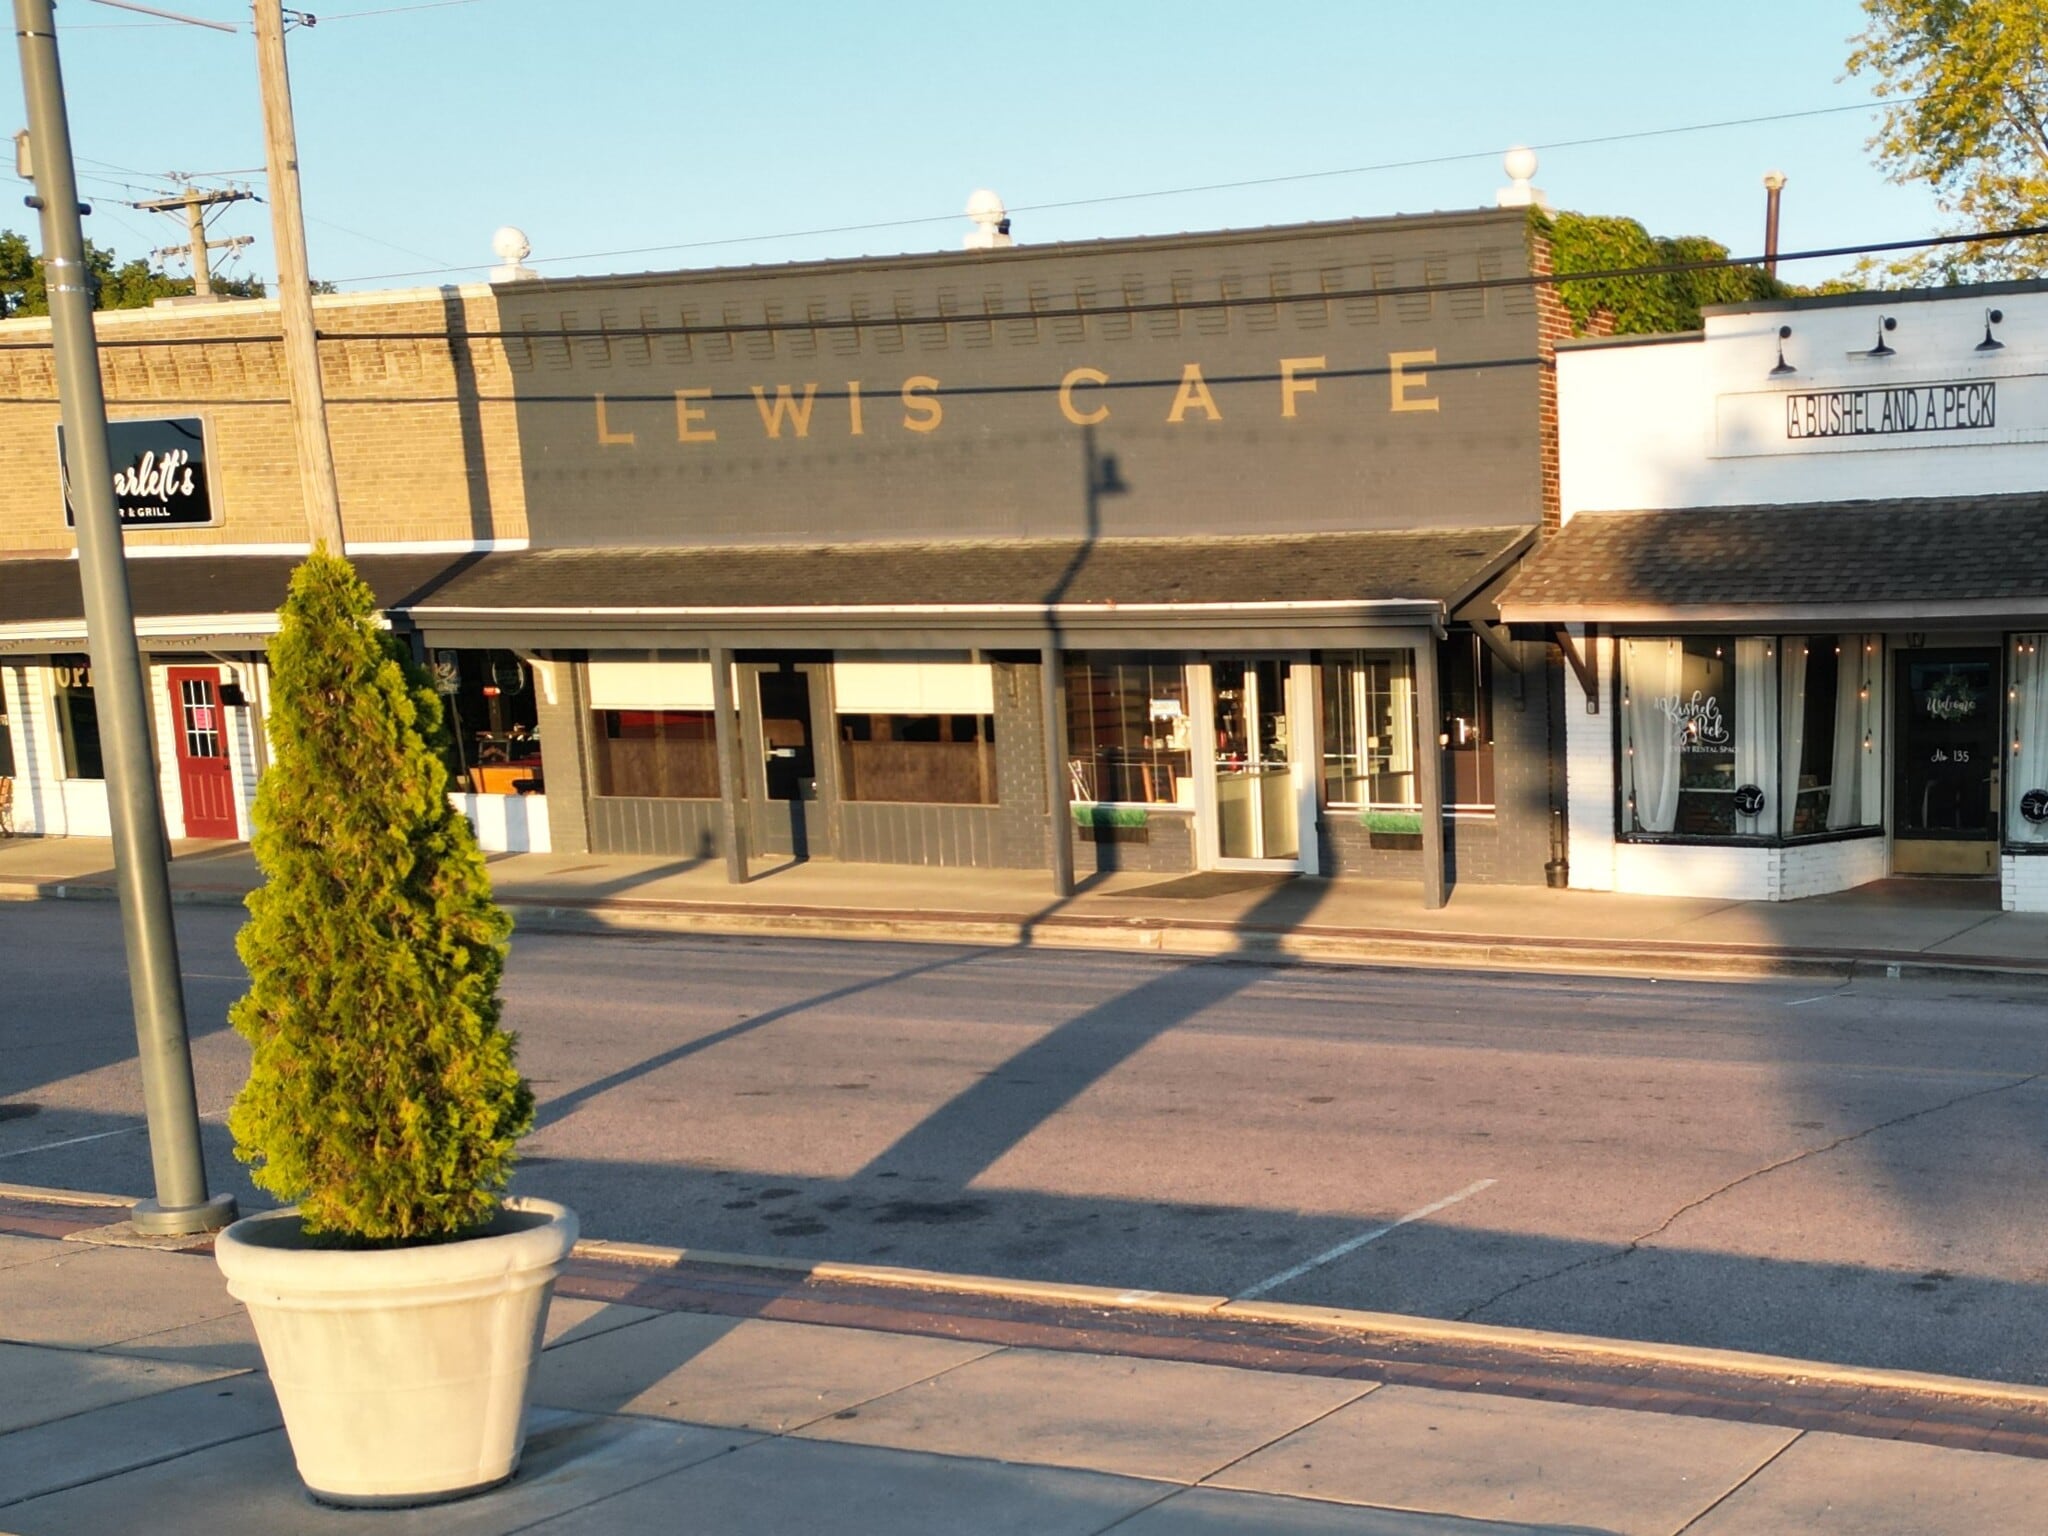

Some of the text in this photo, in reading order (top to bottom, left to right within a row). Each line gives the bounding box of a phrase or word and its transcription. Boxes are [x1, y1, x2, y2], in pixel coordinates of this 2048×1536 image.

[594, 348, 1441, 446] LEWIS CAFE
[1788, 382, 1995, 437] A BUSHEL AND A PECK
[137, 507, 171, 517] GRILL
[1953, 750, 1969, 763] 135
